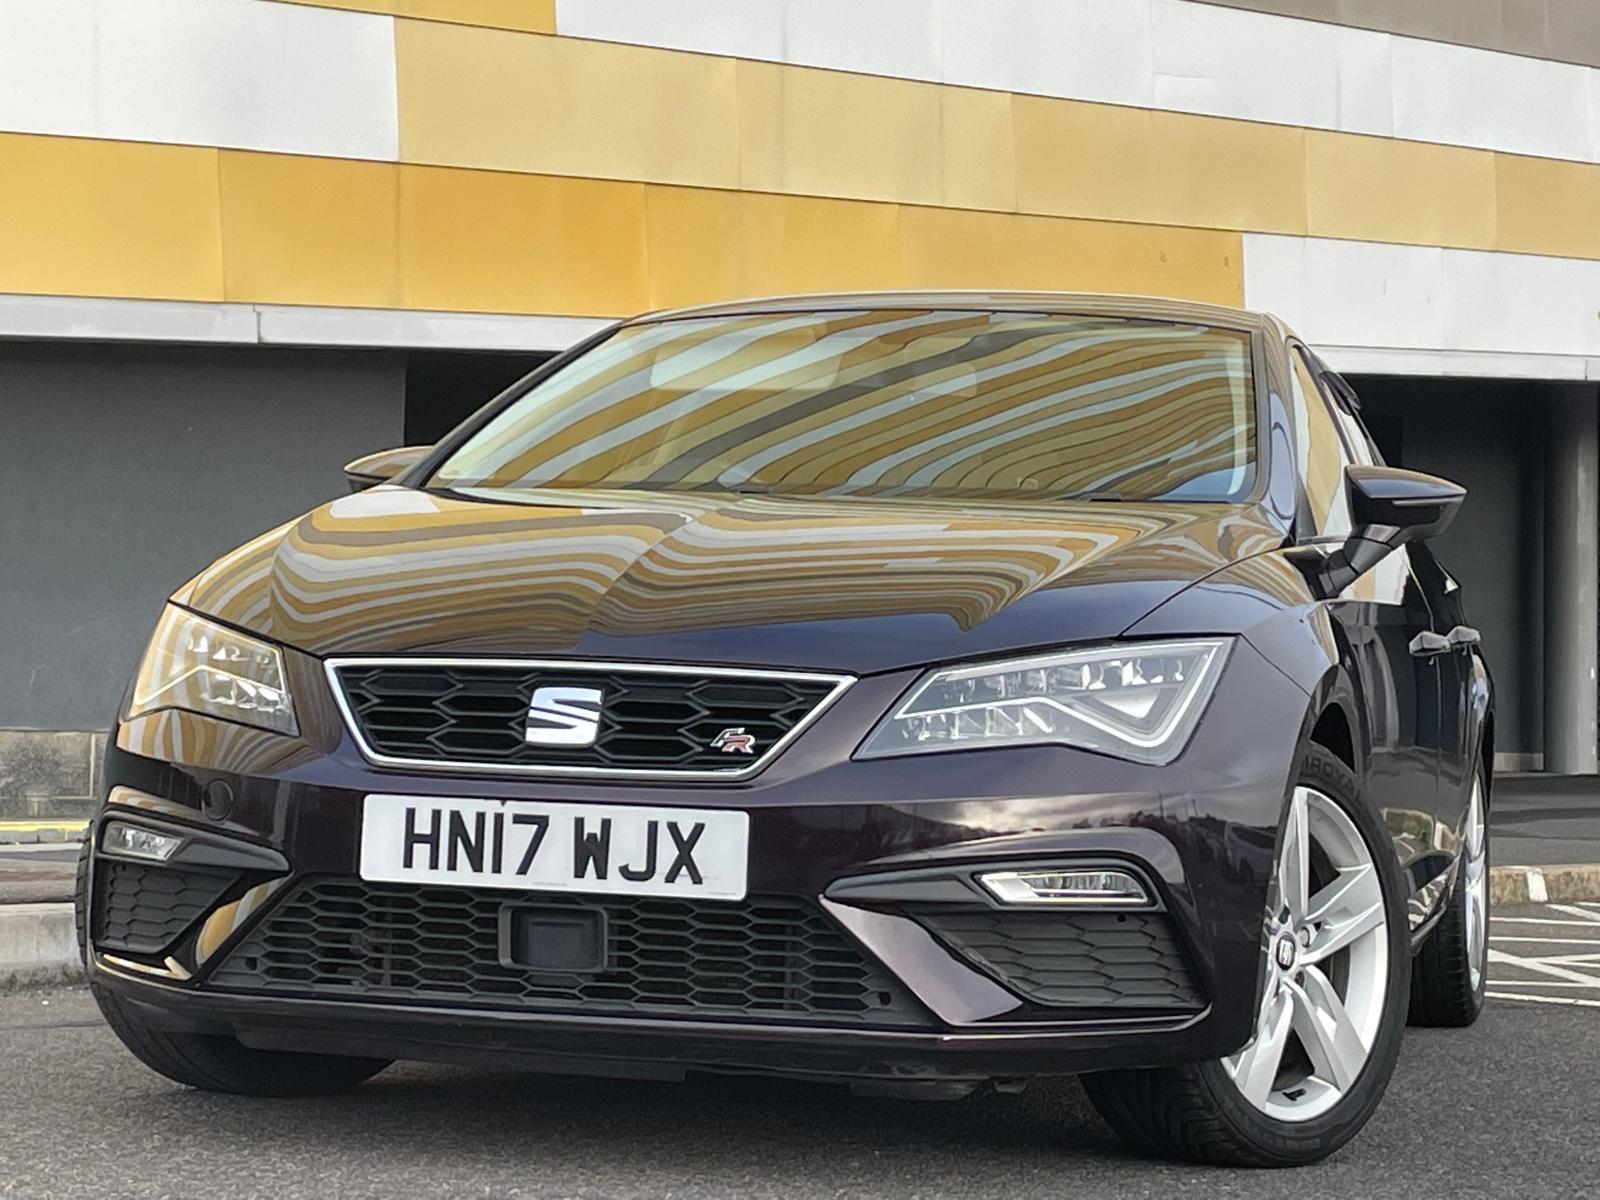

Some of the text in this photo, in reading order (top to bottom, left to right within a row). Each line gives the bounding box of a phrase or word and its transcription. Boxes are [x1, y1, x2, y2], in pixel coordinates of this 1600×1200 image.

[710, 727, 756, 754] FR
[402, 807, 706, 885] HN17 WJX
